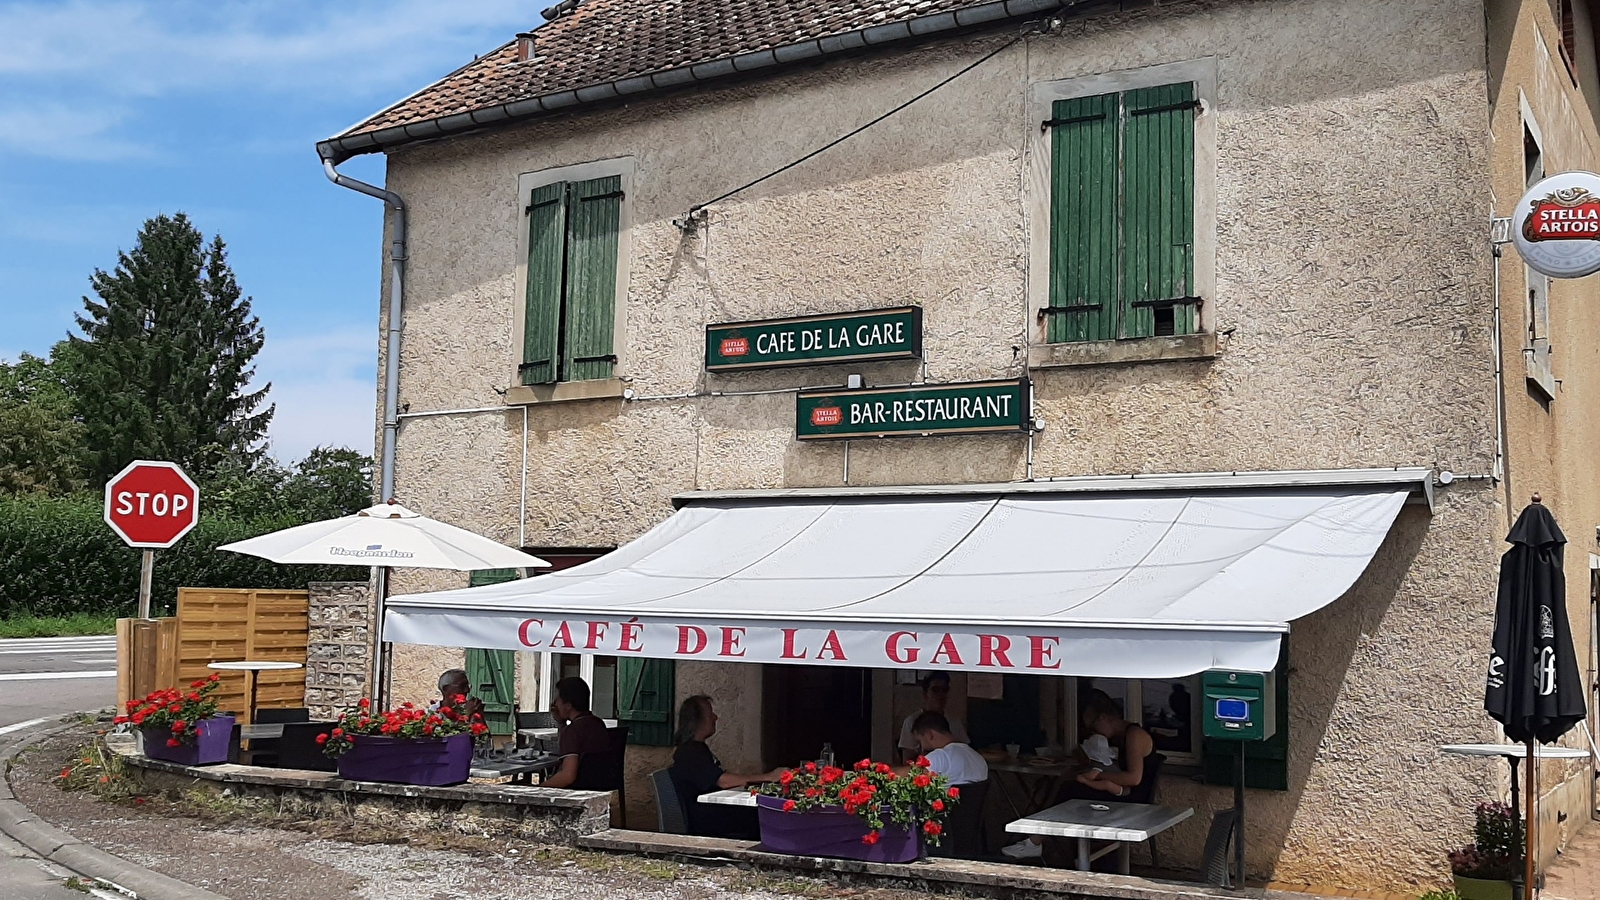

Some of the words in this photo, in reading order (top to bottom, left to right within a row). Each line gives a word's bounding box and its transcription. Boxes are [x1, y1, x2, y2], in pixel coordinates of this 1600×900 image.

[1539, 221, 1598, 232] ARTOIS
[1540, 209, 1598, 221] STELLA
[756, 332, 796, 354] CAFE
[801, 328, 823, 351] DE
[828, 327, 851, 349] LA
[856, 322, 905, 347] GARE
[850, 394, 1012, 424] BAR-RESTAURANT
[116, 491, 188, 517] STOP
[517, 617, 644, 652] CAFÉ
[674, 625, 747, 657] DE
[779, 628, 848, 660] LA
[884, 631, 1062, 669] GARE
